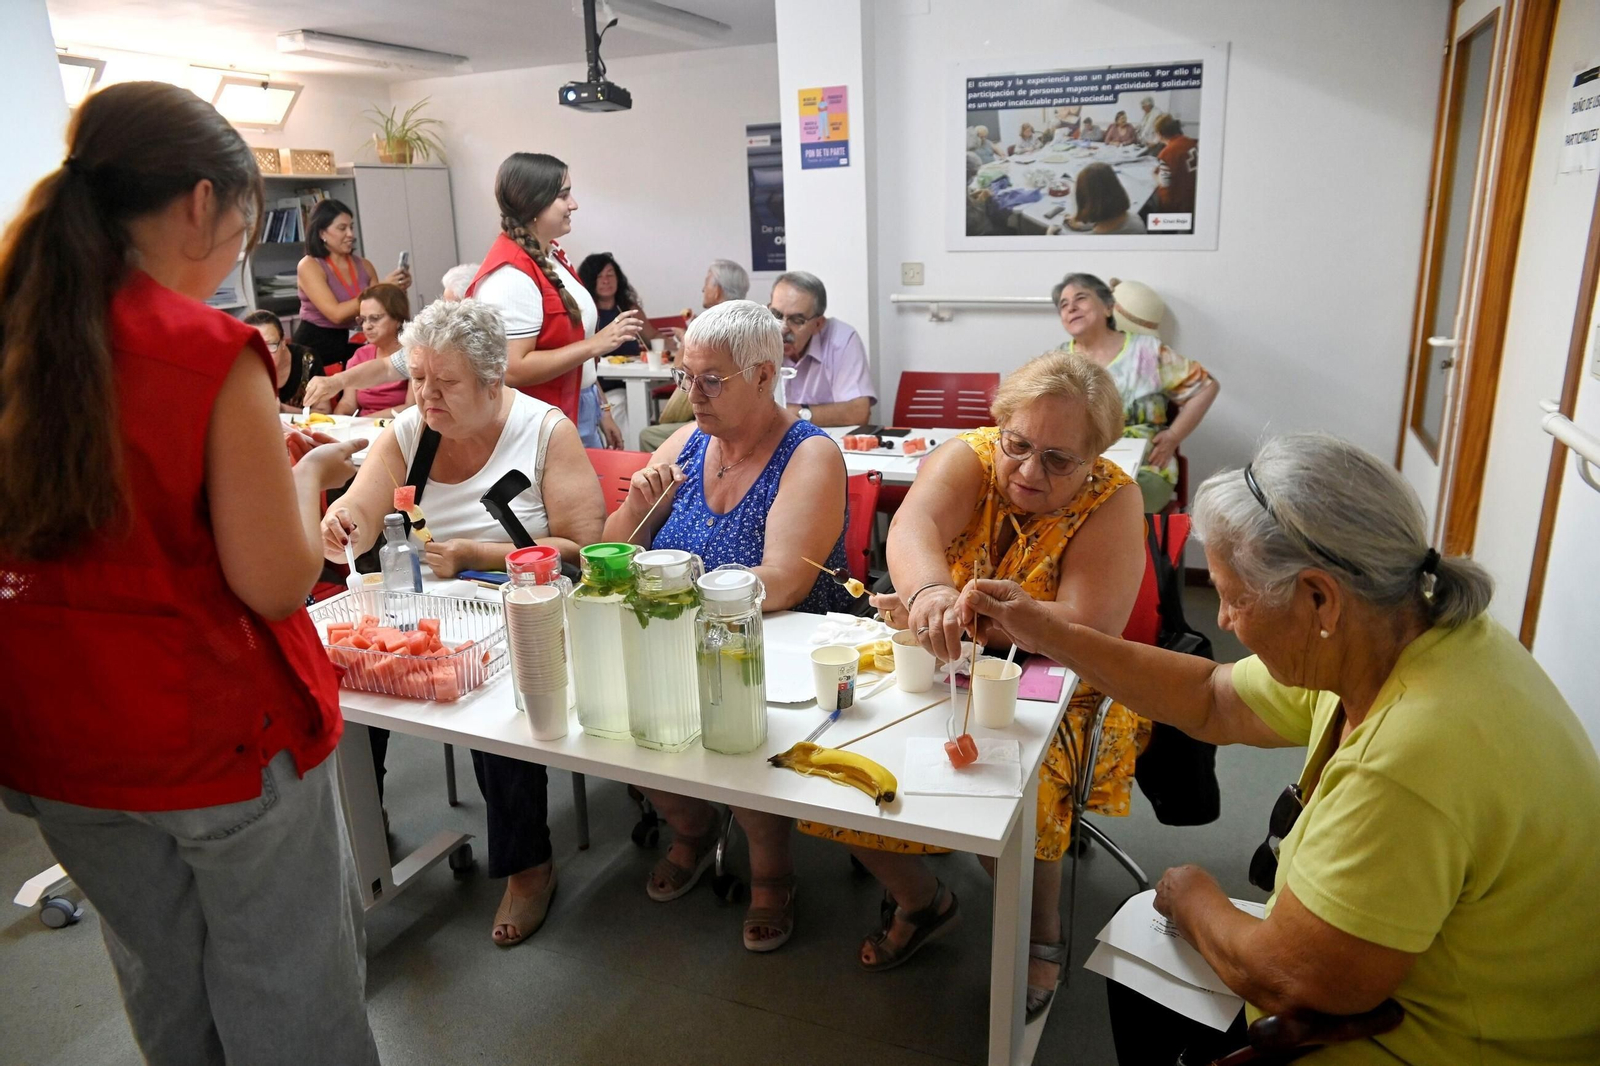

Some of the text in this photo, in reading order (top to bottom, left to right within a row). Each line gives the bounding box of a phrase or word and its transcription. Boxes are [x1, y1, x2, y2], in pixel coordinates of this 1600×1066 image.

[968, 80, 975, 88] El
[978, 80, 1004, 88] tiempo
[1007, 79, 1013, 88] y
[1027, 75, 1070, 86] experiencia
[1106, 70, 1152, 81] patrimonio.
[1173, 67, 1189, 75] ello
[968, 90, 1015, 100] participación
[1029, 87, 1064, 97] personas
[1066, 85, 1099, 95] mayores
[1114, 81, 1159, 90] actividades
[1162, 78, 1201, 88] solidarias
[988, 100, 1007, 108] valor
[1008, 97, 1051, 107] incalculable
[1053, 97, 1070, 106] para
[1080, 94, 1116, 103] sociedad.
[830, 146, 846, 156] PARTE
